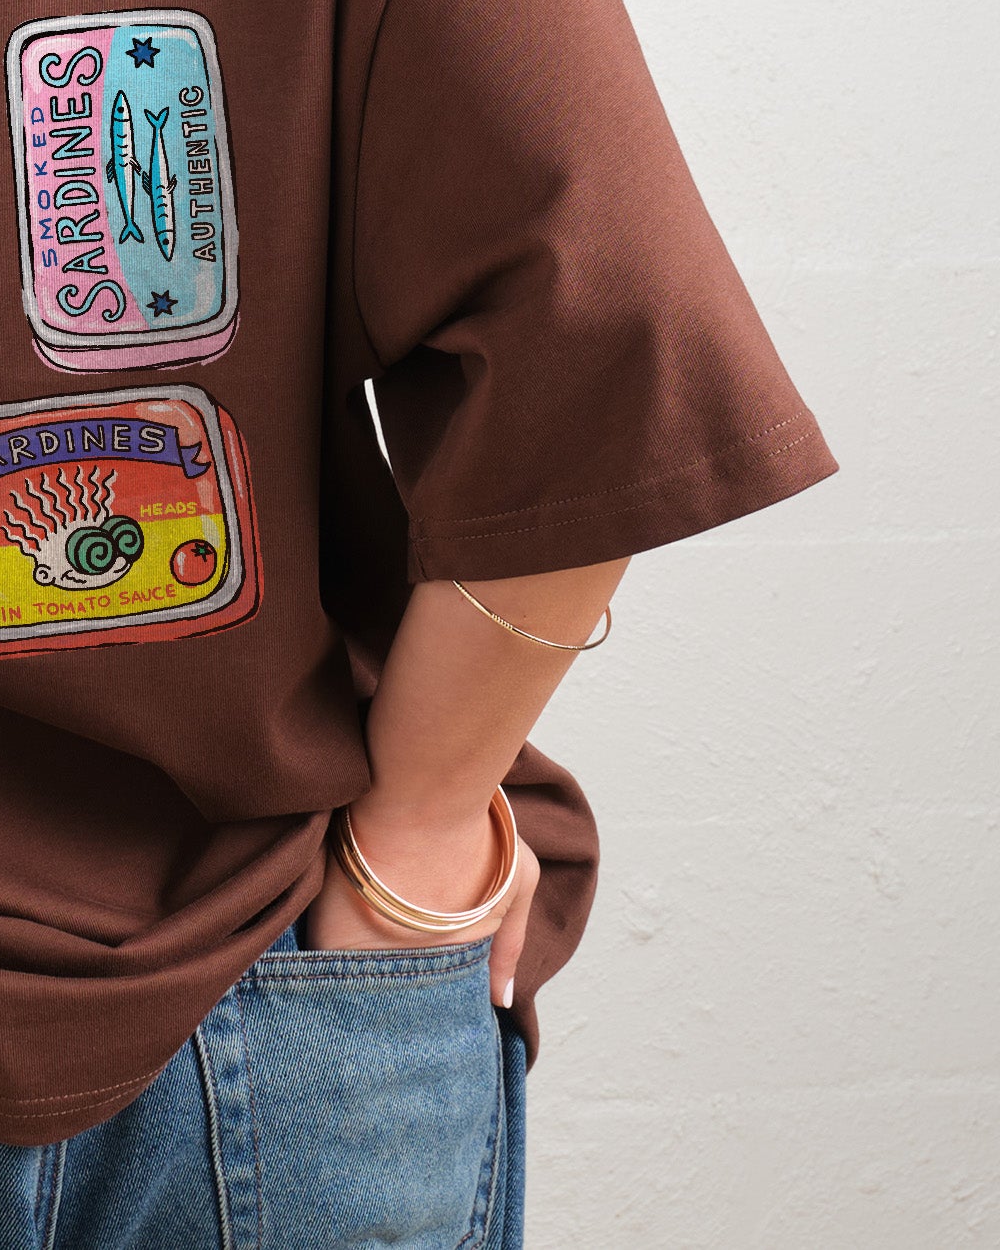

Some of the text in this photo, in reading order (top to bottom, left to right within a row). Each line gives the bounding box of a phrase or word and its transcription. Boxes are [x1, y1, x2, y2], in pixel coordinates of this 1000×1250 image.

[31, 107, 58, 268] SMOKED
[39, 46, 127, 322] SARDINES
[179, 86, 217, 263] AUTHENTIC
[140, 501, 198, 518] HEADS
[1, 584, 177, 623] IN TOMATO SAUCE
